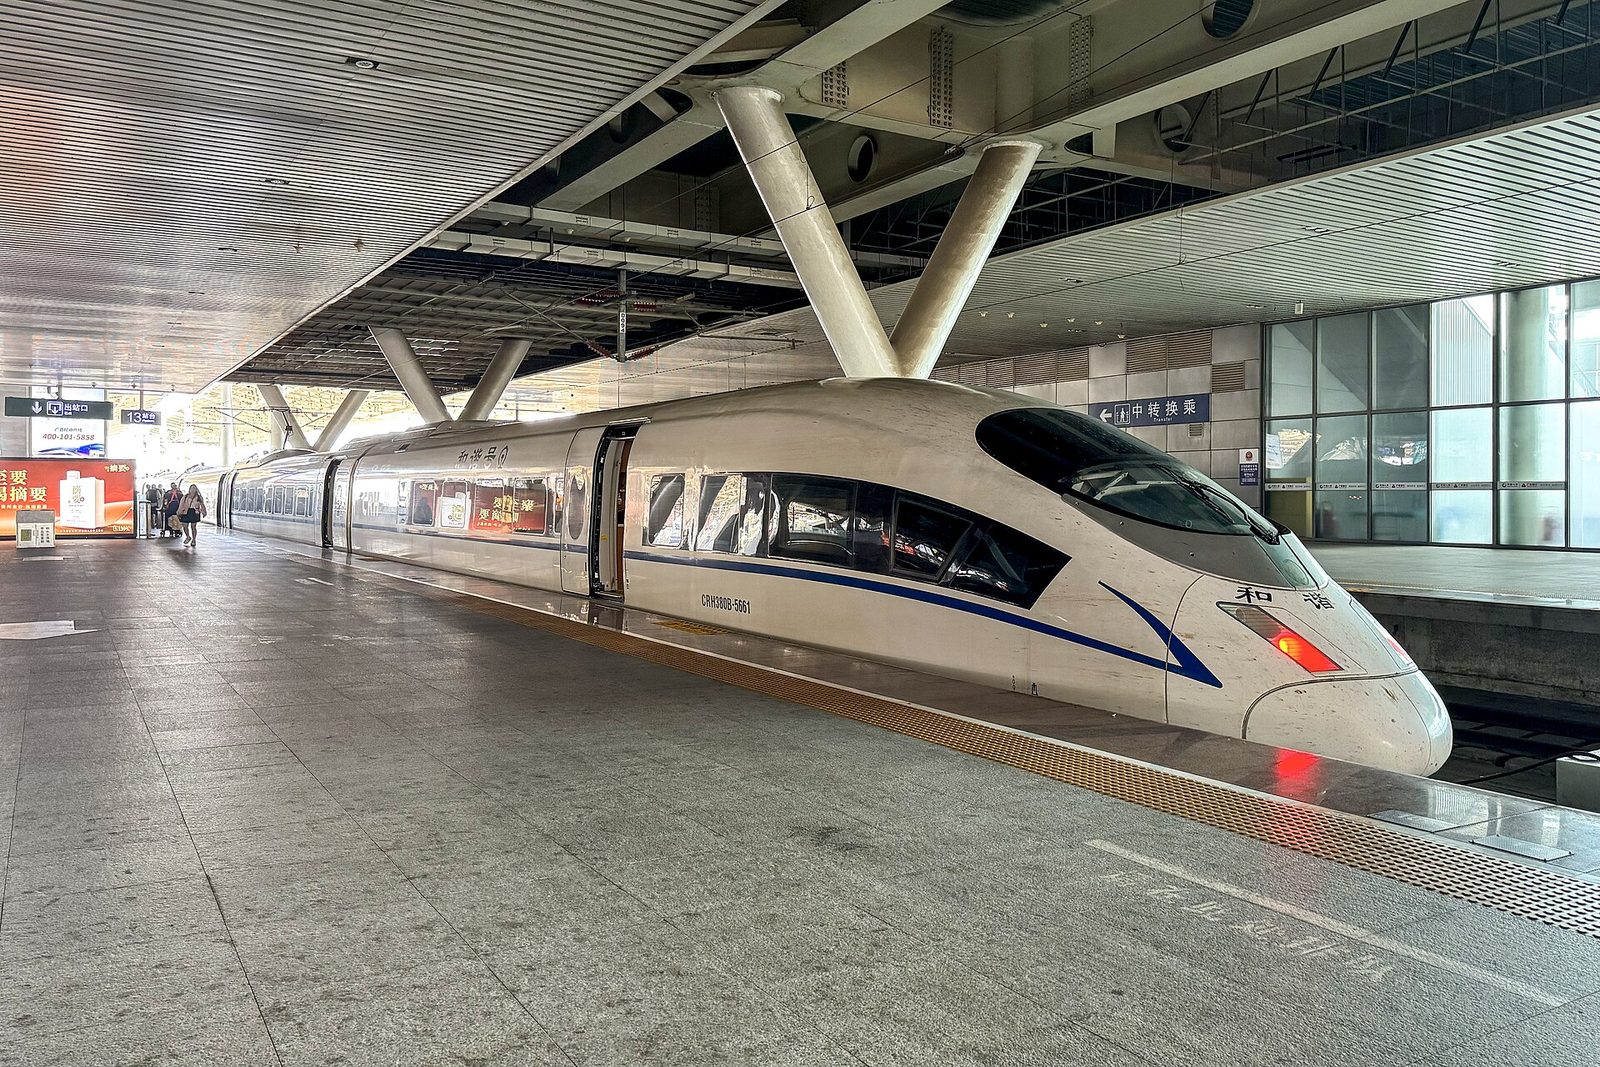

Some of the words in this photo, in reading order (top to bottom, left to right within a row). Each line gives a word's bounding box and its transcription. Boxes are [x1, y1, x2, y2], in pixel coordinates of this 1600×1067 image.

[64, 403, 88, 413] 出站口
[1132, 398, 1196, 419] 中转换乘
[42, 433, 95, 441] 400-101-5858
[457, 445, 498, 463] 和谐号
[701, 593, 751, 614] CRH380B-5661
